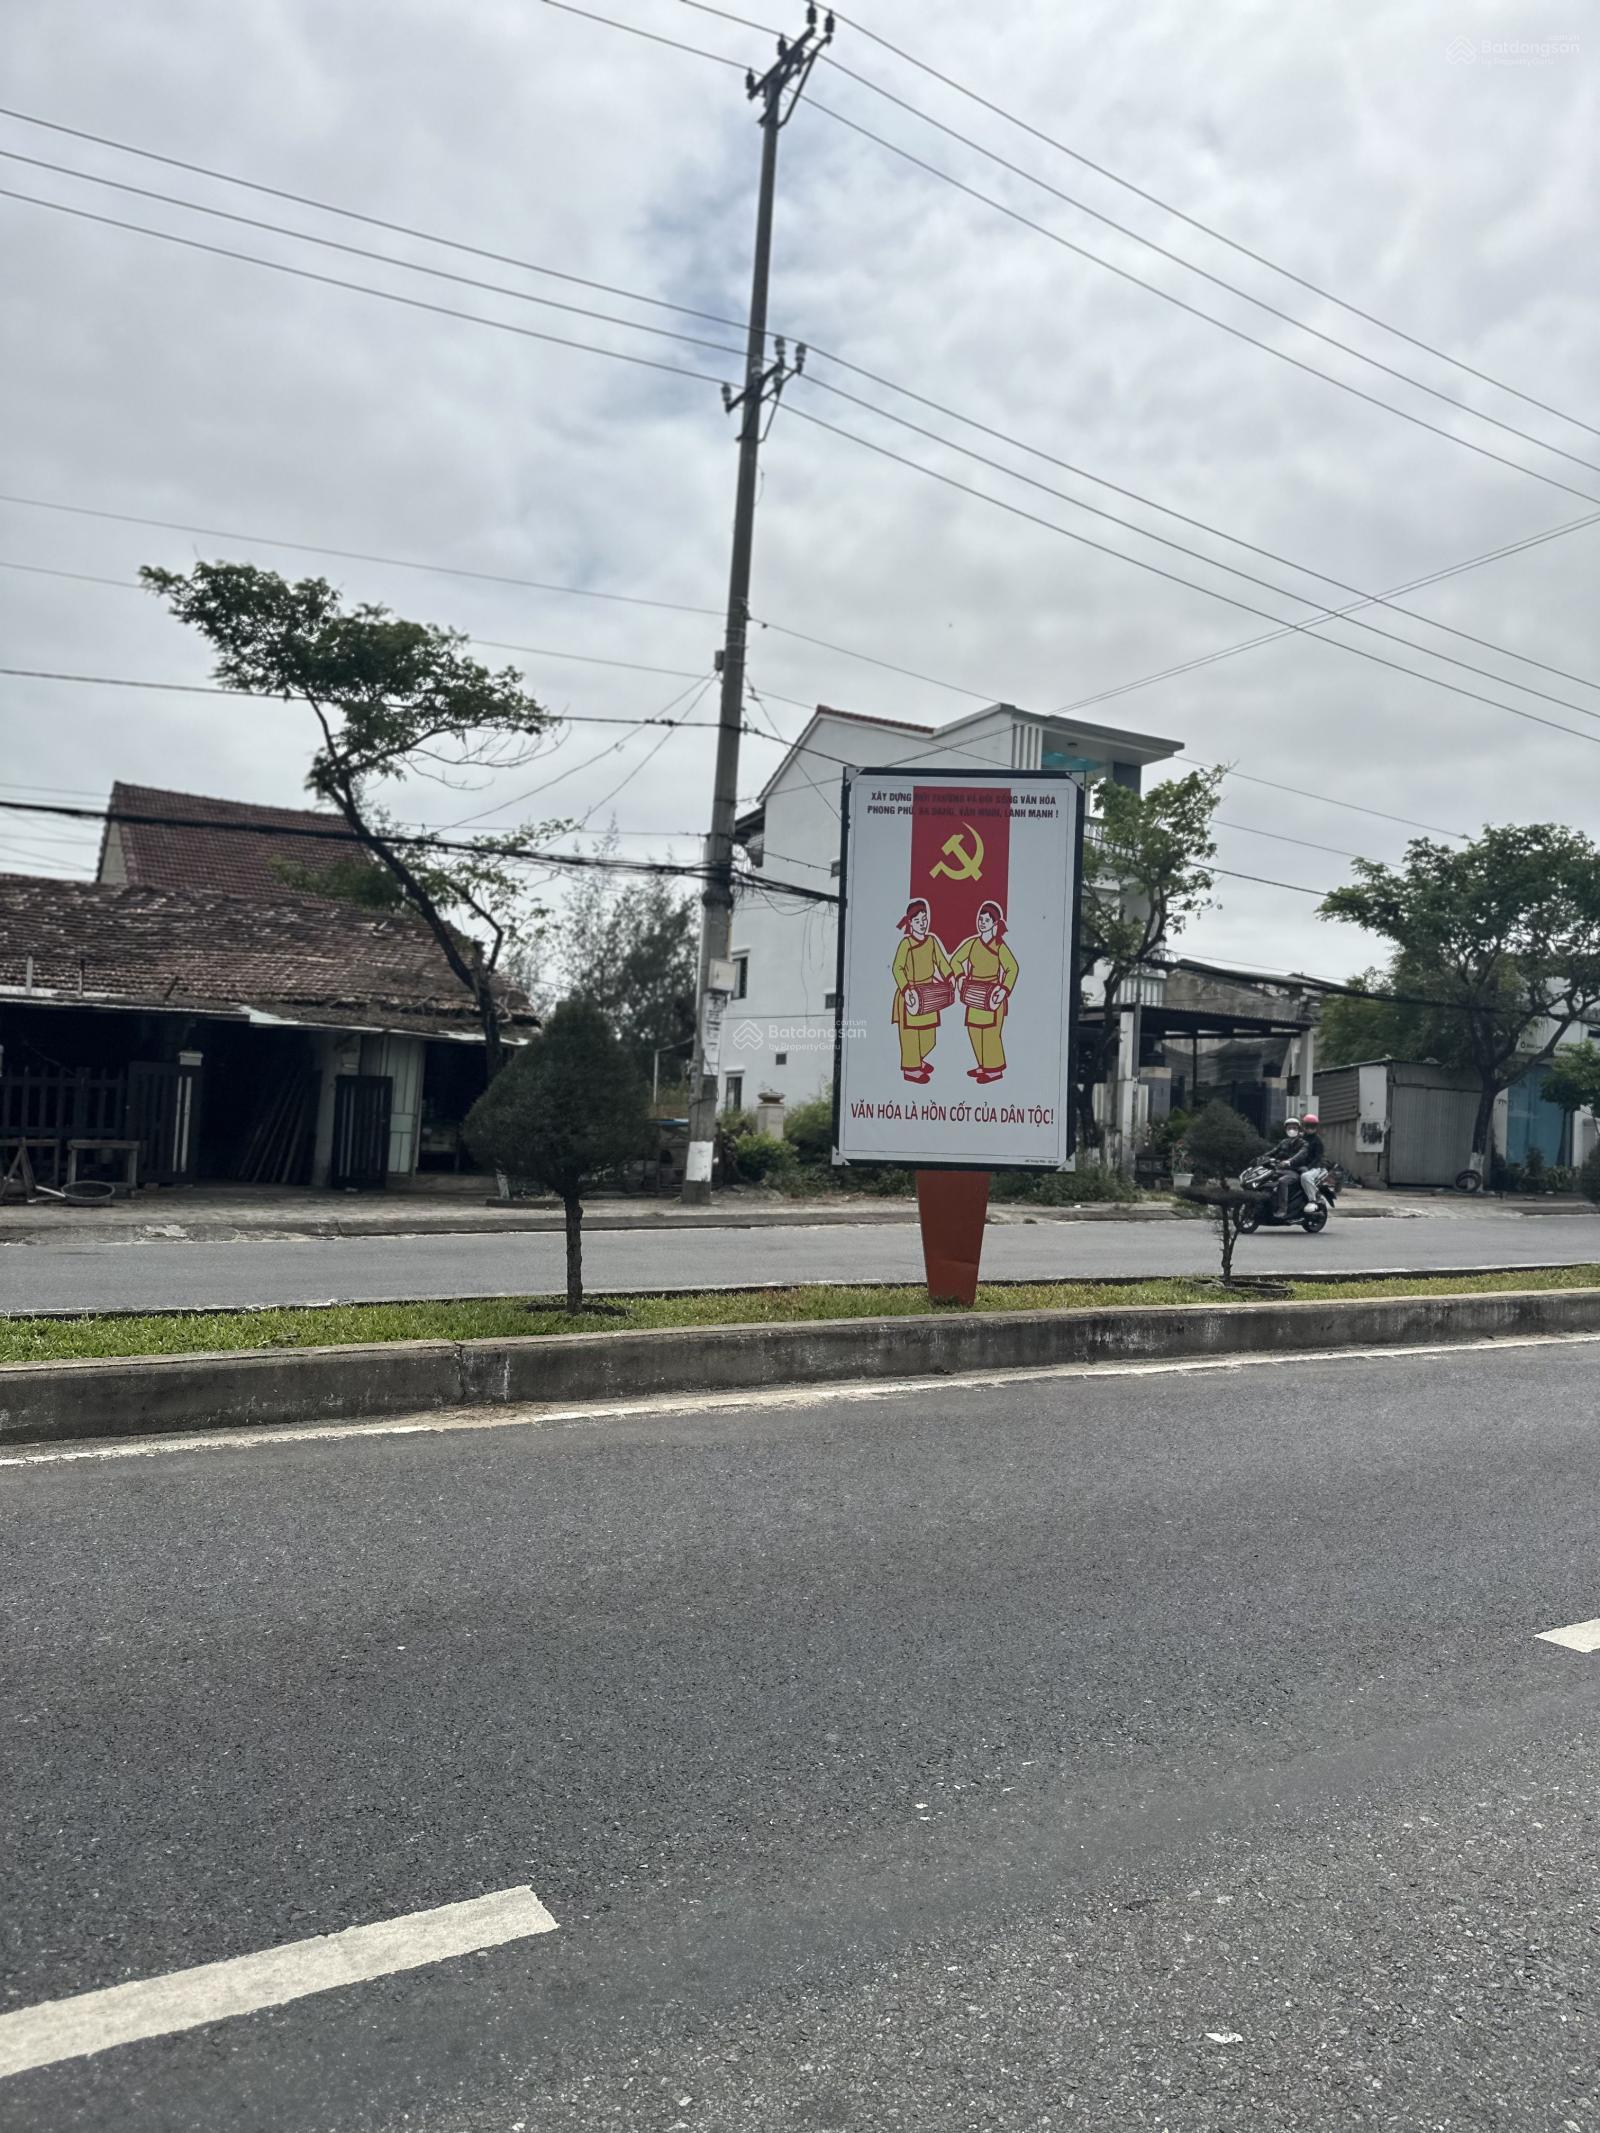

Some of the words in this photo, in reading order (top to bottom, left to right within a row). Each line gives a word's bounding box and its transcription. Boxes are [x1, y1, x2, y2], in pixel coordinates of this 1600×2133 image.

[871, 791, 887, 801] XÂY
[889, 791, 912, 803] DỰNG
[1020, 794, 1037, 804] VĂN
[1039, 794, 1056, 805] HÓA
[867, 805, 895, 815] PHONG
[1028, 809, 1053, 820] MẠNH
[851, 1099, 874, 1118] VĂN
[877, 1100, 902, 1120] HÓA
[905, 1100, 918, 1120] LÀ
[921, 1099, 946, 1121] HỒN
[950, 1101, 972, 1122] CỐT
[974, 1101, 998, 1122] CỦA
[1000, 1104, 1025, 1123] DÂN
[1028, 1104, 1054, 1127] TỘC!
